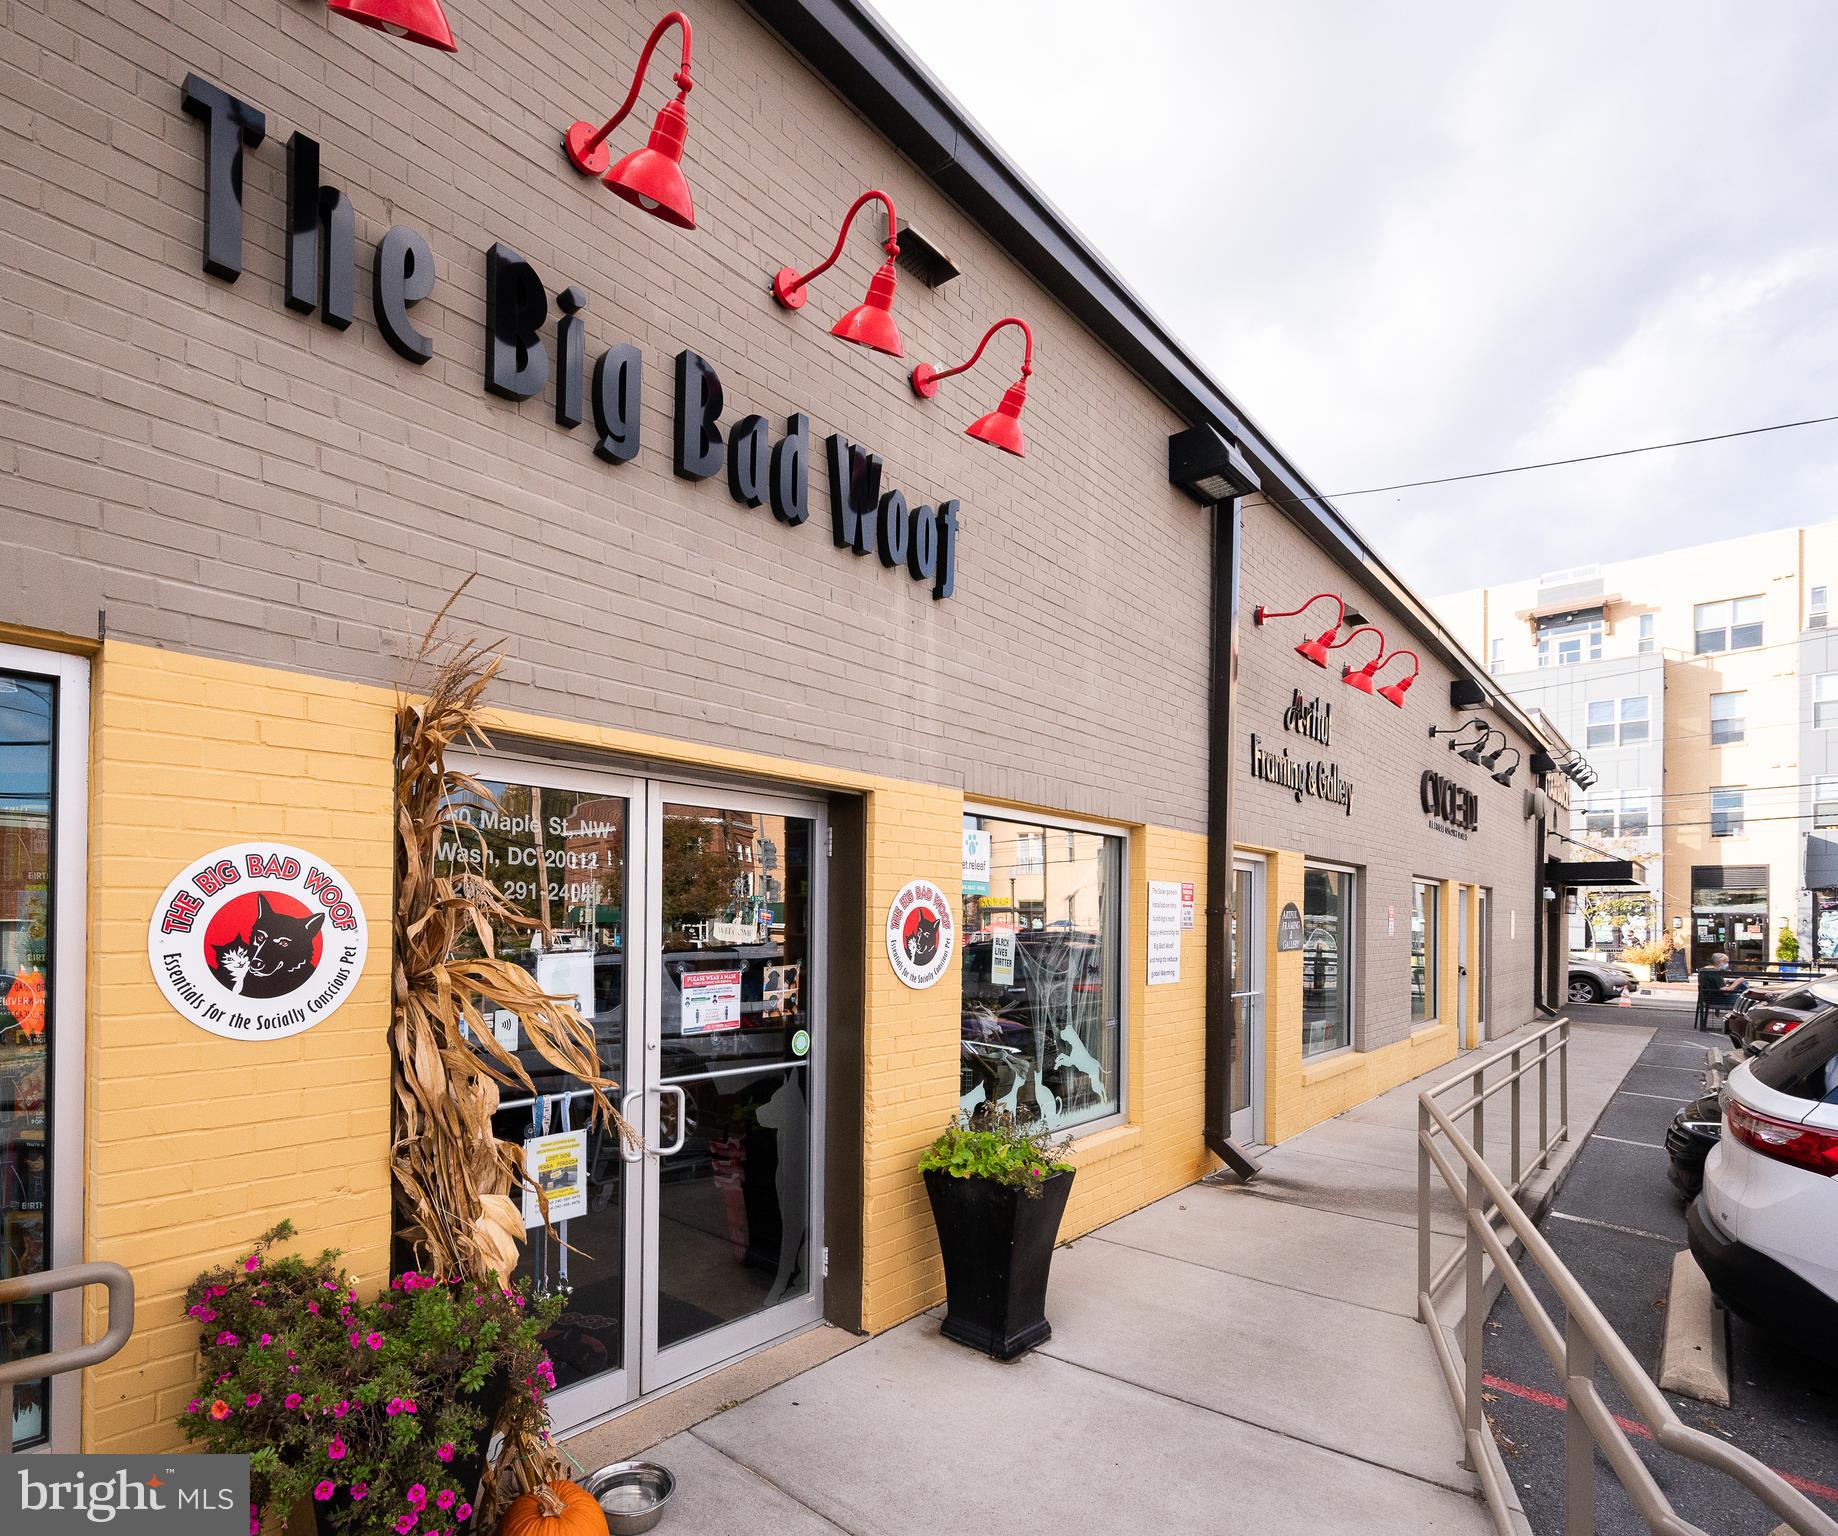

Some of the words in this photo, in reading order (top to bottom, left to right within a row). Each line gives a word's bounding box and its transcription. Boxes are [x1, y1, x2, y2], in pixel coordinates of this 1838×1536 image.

[181, 71, 436, 366] The
[484, 242, 642, 465] Big
[674, 349, 810, 527] Bad
[825, 433, 961, 600] Woof
[1251, 733, 1304, 803] Framing
[1306, 761, 1317, 796] &
[1316, 760, 1354, 817] Gallery
[480, 810, 542, 835] Maple
[581, 820, 609, 839] NW
[507, 847, 538, 866] DC
[161, 890, 204, 935] THE
[192, 860, 241, 897] BIG
[246, 853, 301, 880] BAD
[304, 867, 357, 932] WOOF
[890, 906, 904, 930] THE
[900, 889, 914, 911] BIG
[915, 885, 933, 902] BAD
[933, 893, 951, 930] WOOF
[890, 939, 904, 971] Essentials
[902, 967, 910, 978] for
[909, 973, 917, 984] the
[917, 970, 934, 984] Socially
[933, 950, 949, 976] Conscious
[994, 947, 1008, 957] LIVES
[994, 957, 1012, 968] MATTER
[995, 937, 1010, 948] BLACK
[163, 952, 206, 1010] Essentials
[202, 1003, 226, 1023] for
[229, 1013, 252, 1030] the
[256, 1008, 306, 1031] Socially
[307, 968, 352, 1014] Conscious
[340, 945, 357, 965] Pet
